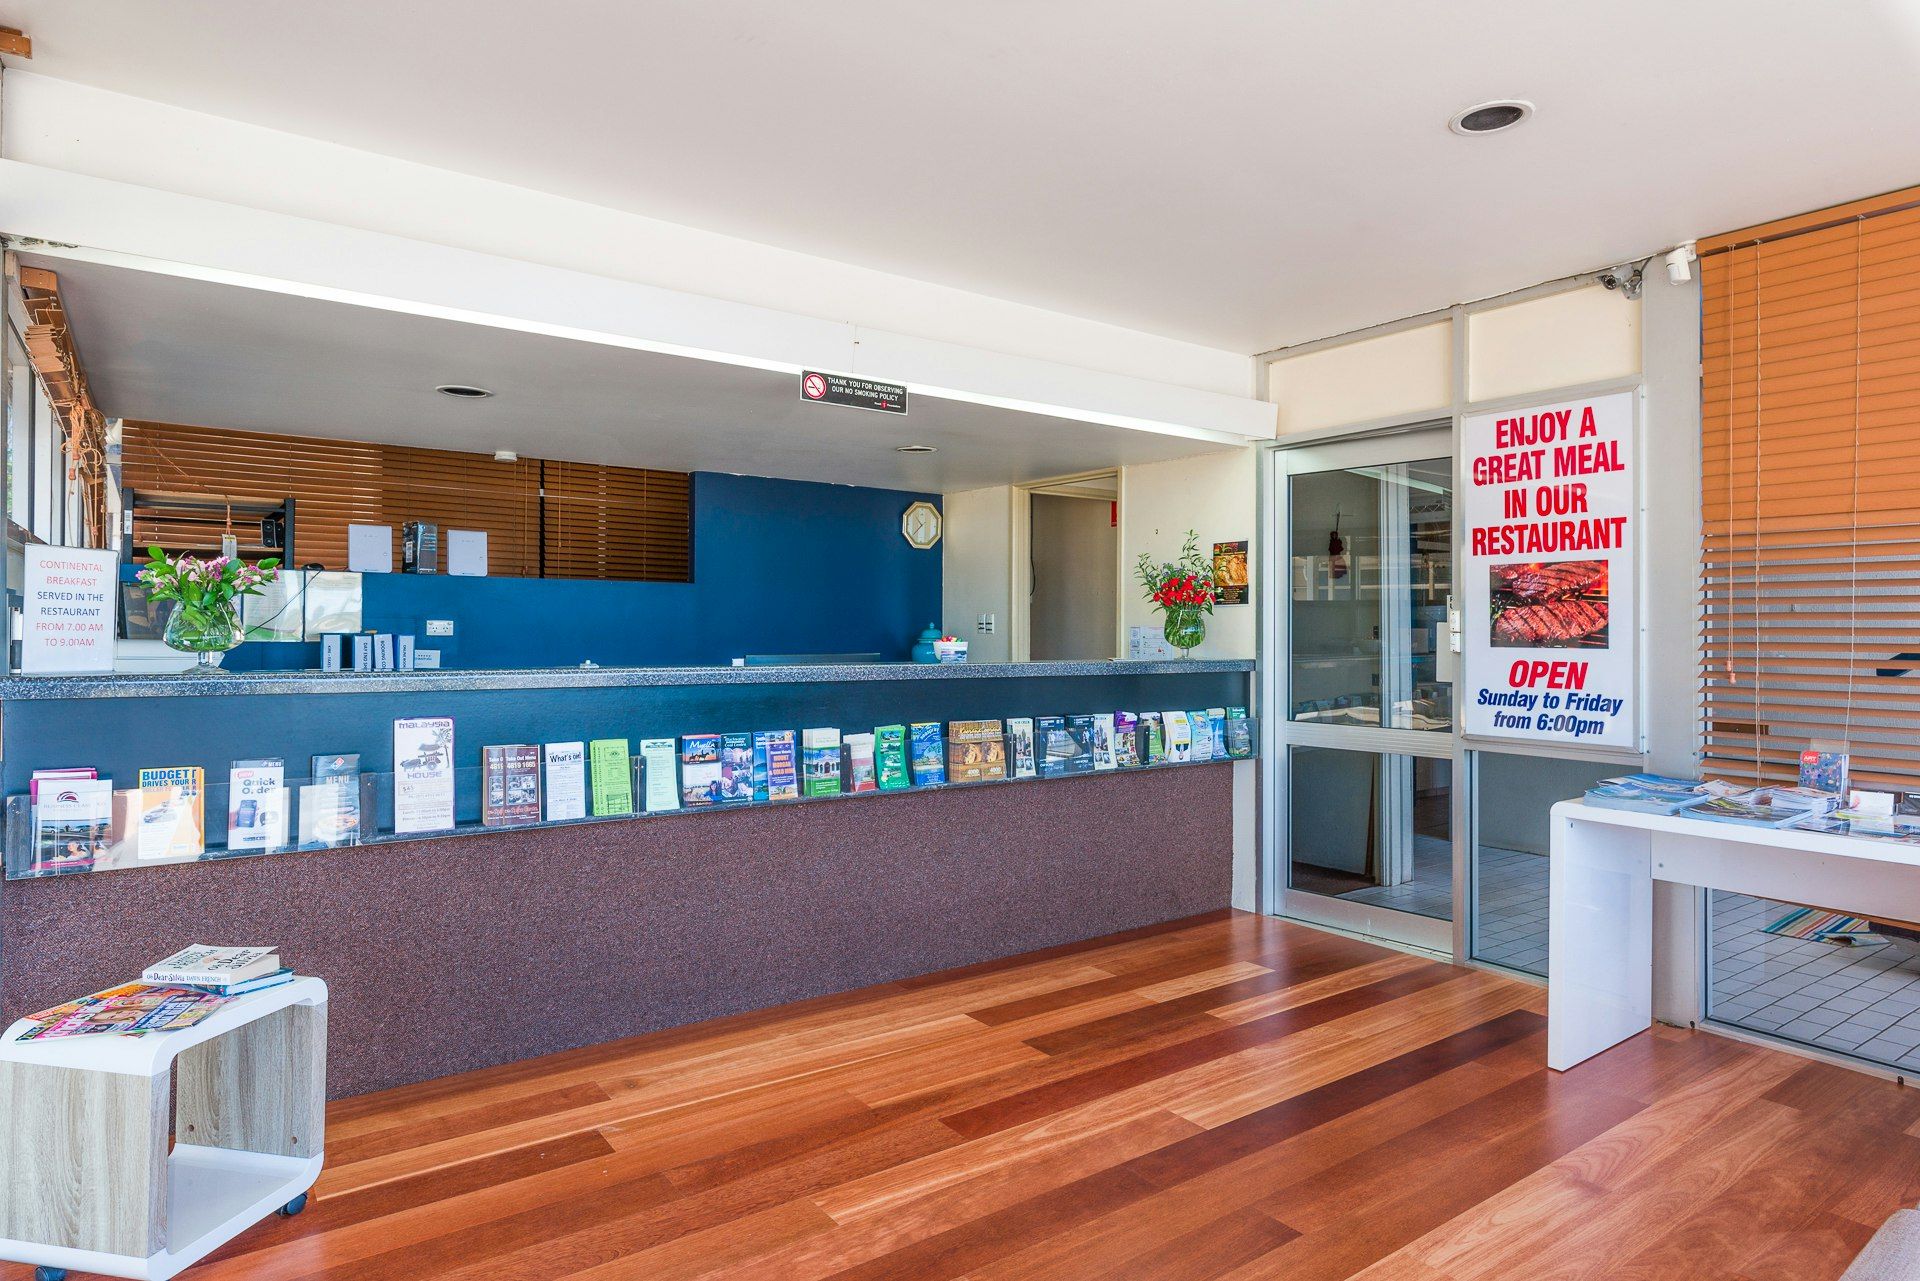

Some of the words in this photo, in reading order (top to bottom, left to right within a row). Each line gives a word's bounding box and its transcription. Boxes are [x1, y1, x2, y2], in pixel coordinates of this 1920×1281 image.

[828, 377, 847, 386] THANK
[849, 379, 861, 388] YOU
[862, 381, 872, 390] FOR
[874, 383, 903, 395] OBSERVING
[832, 385, 843, 393] OUR
[845, 387, 853, 395] NO
[855, 388, 878, 399] SMOKING
[879, 391, 898, 402] POLICY
[1496, 409, 1572, 449] ENJOY
[1579, 406, 1597, 438] A
[1473, 449, 1545, 487] GREAT
[1554, 440, 1625, 478] MEAL
[1504, 488, 1527, 519] IN
[1536, 482, 1588, 517] OUR
[1472, 516, 1627, 557] RESTAURANT
[40, 560, 103, 572] CONTINENTAL
[46, 576, 97, 587] BREAKFAST
[37, 591, 73, 600] SERVED
[75, 593, 85, 601] IN
[87, 593, 104, 602] THE
[40, 607, 101, 617] RESTAURANT
[36, 623, 64, 631] FROM
[88, 623, 104, 632] AM
[45, 638, 57, 647] TO
[1508, 659, 1589, 690] OPEN
[1477, 688, 1538, 711] Sunday
[1543, 692, 1559, 710] to
[1565, 692, 1624, 717] Friday
[1493, 710, 1531, 730] from
[1536, 713, 1605, 737] 6:00pm
[550, 754, 572, 763] What's
[142, 770, 190, 781] BUDGET
[325, 775, 350, 784] MENU
[243, 777, 275, 787] Quick
